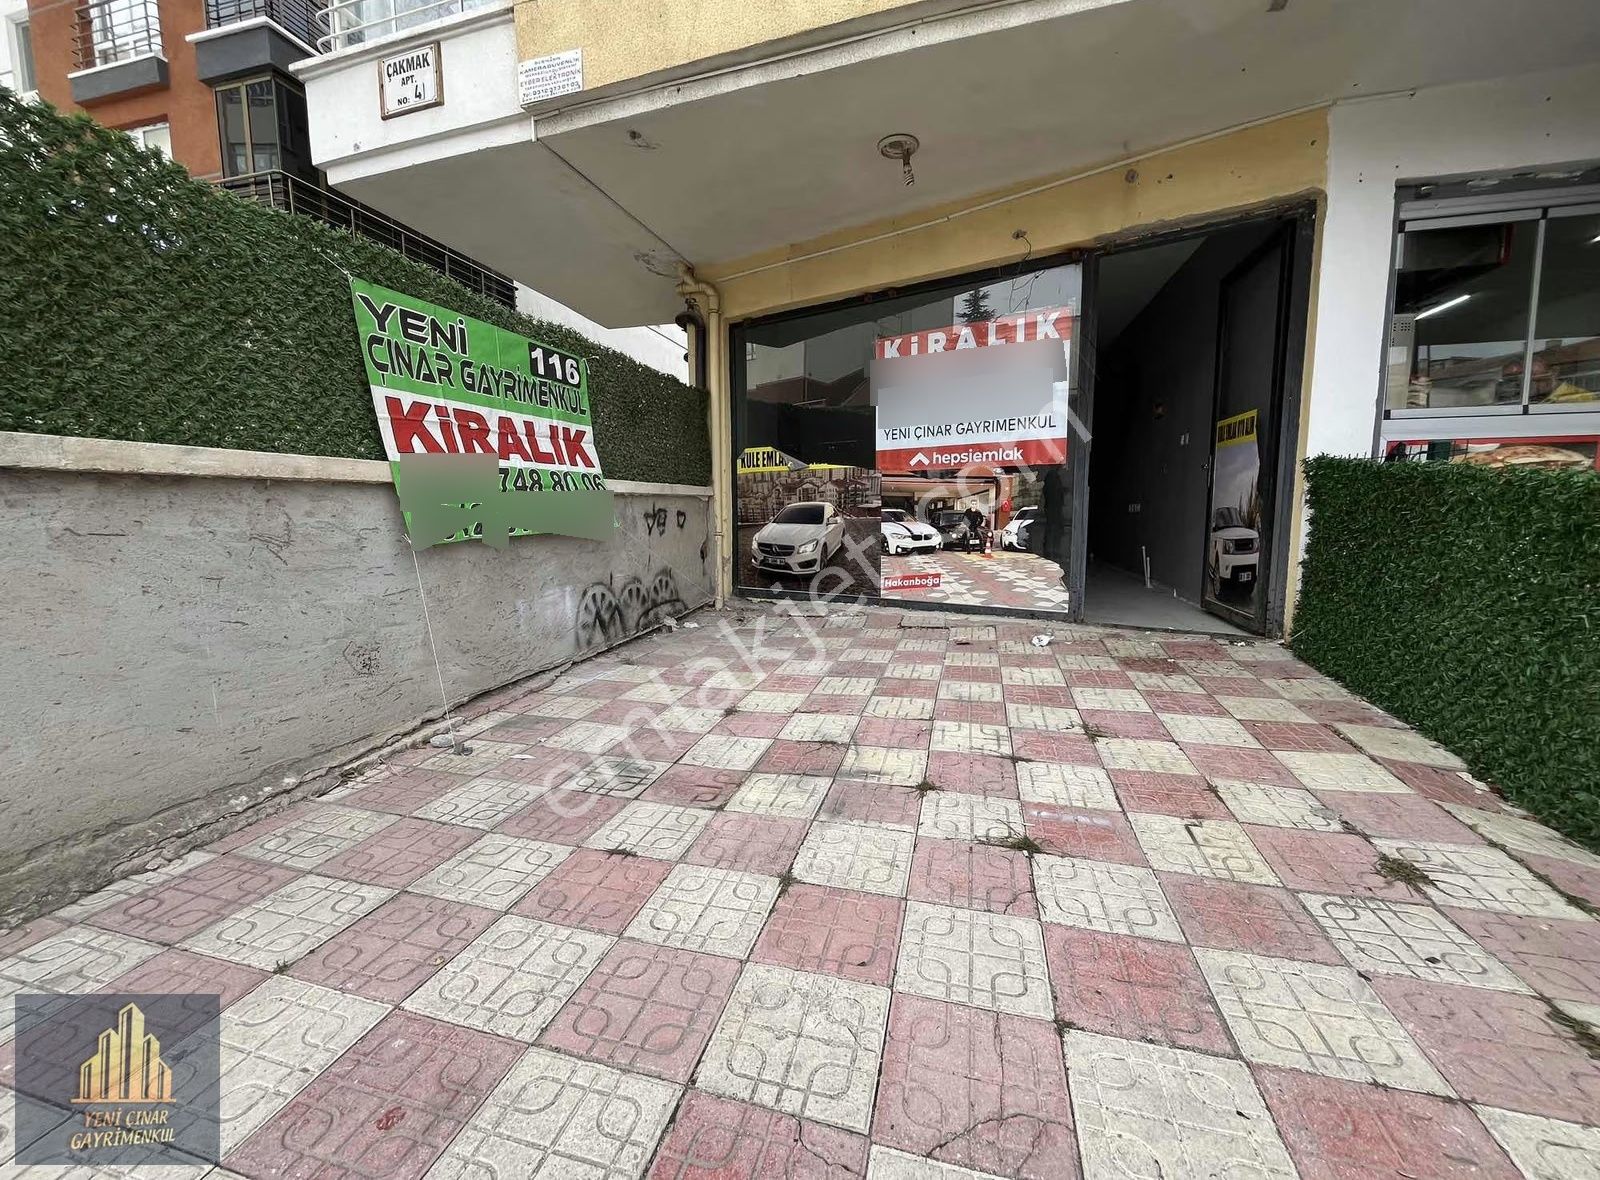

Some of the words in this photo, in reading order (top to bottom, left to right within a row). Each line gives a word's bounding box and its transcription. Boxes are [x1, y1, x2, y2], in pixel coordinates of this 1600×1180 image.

[386, 52, 430, 83] ÇAKMAK
[401, 74, 417, 87] APT.
[397, 96, 411, 106] NO:
[355, 292, 469, 356] YENİ
[884, 311, 1060, 359] KİRALIK
[366, 334, 456, 386] ÇINAR
[530, 346, 580, 385] 116
[384, 395, 596, 468] KİRALIK
[914, 424, 952, 440] ÇINAR
[741, 451, 760, 469] KULE
[932, 447, 1024, 466] hepsiemlak
[884, 576, 940, 588] Hakanboğa
